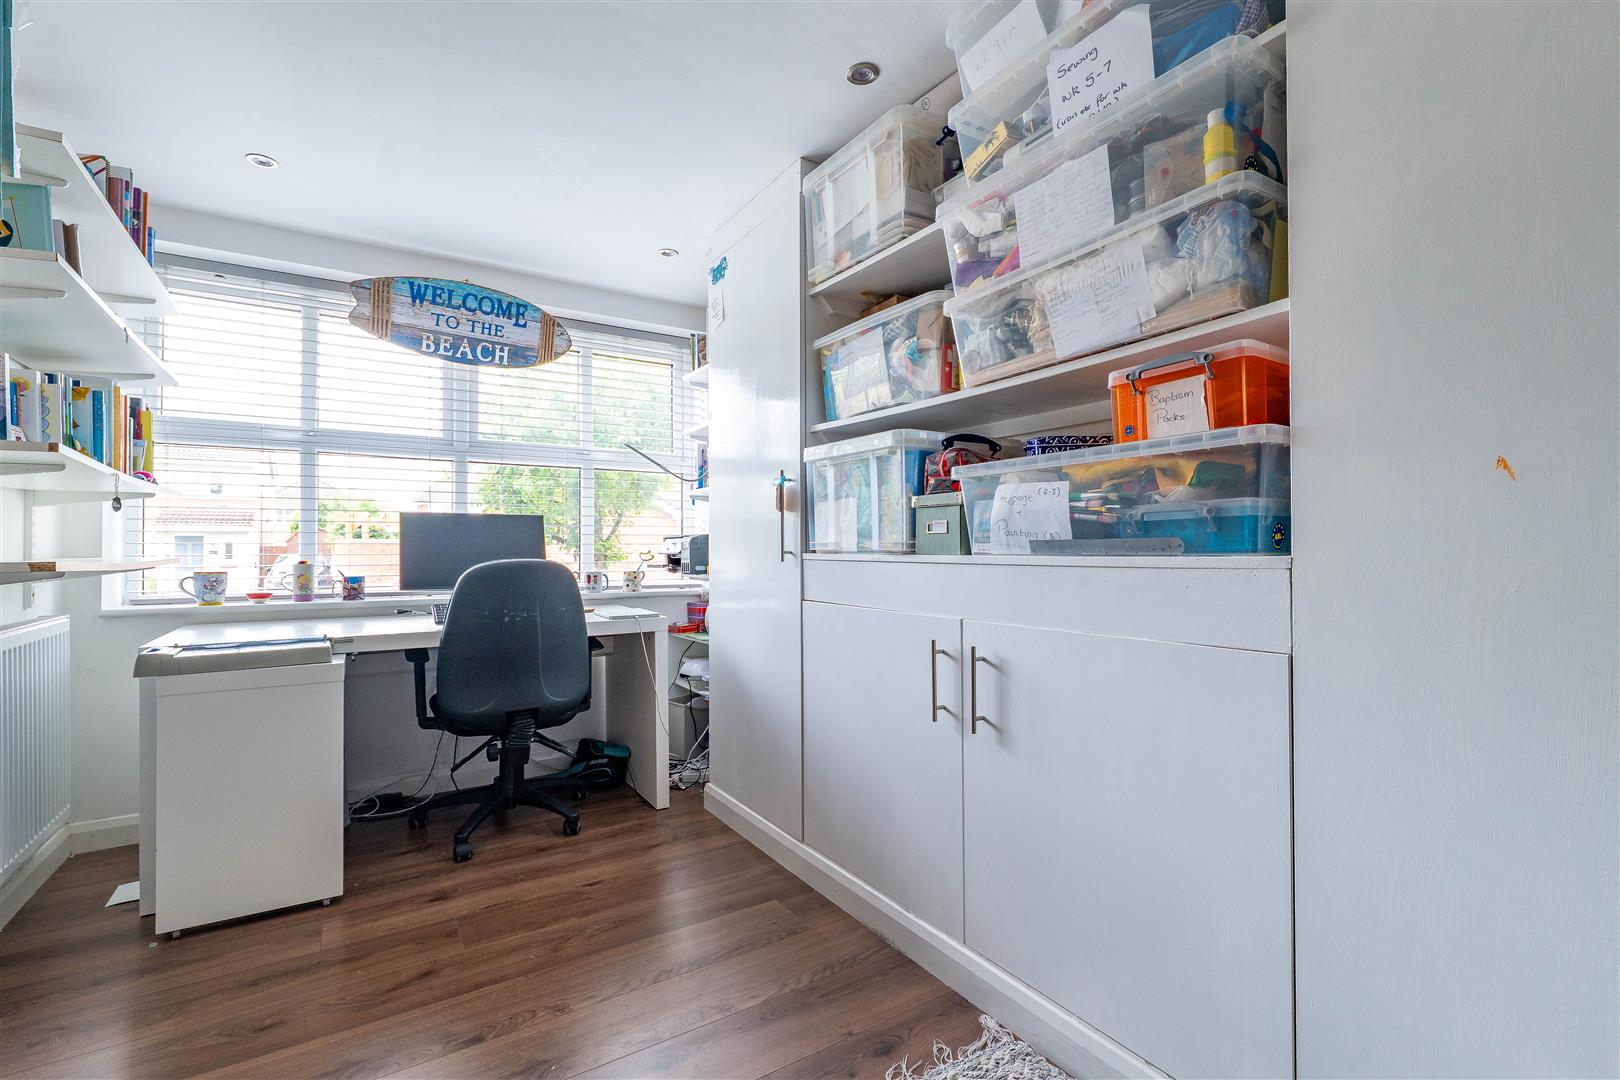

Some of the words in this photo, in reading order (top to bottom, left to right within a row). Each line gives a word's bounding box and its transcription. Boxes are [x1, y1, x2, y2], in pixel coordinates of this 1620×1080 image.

[1057, 47, 1098, 79] Sewing
[1085, 60, 1112, 88] 5-7
[408, 281, 528, 329] WELCOME
[430, 312, 460, 330] TO
[467, 319, 505, 338] THE
[421, 333, 511, 366] BEACH
[1148, 389, 1194, 407] Baptism
[1152, 407, 1185, 425] Packs
